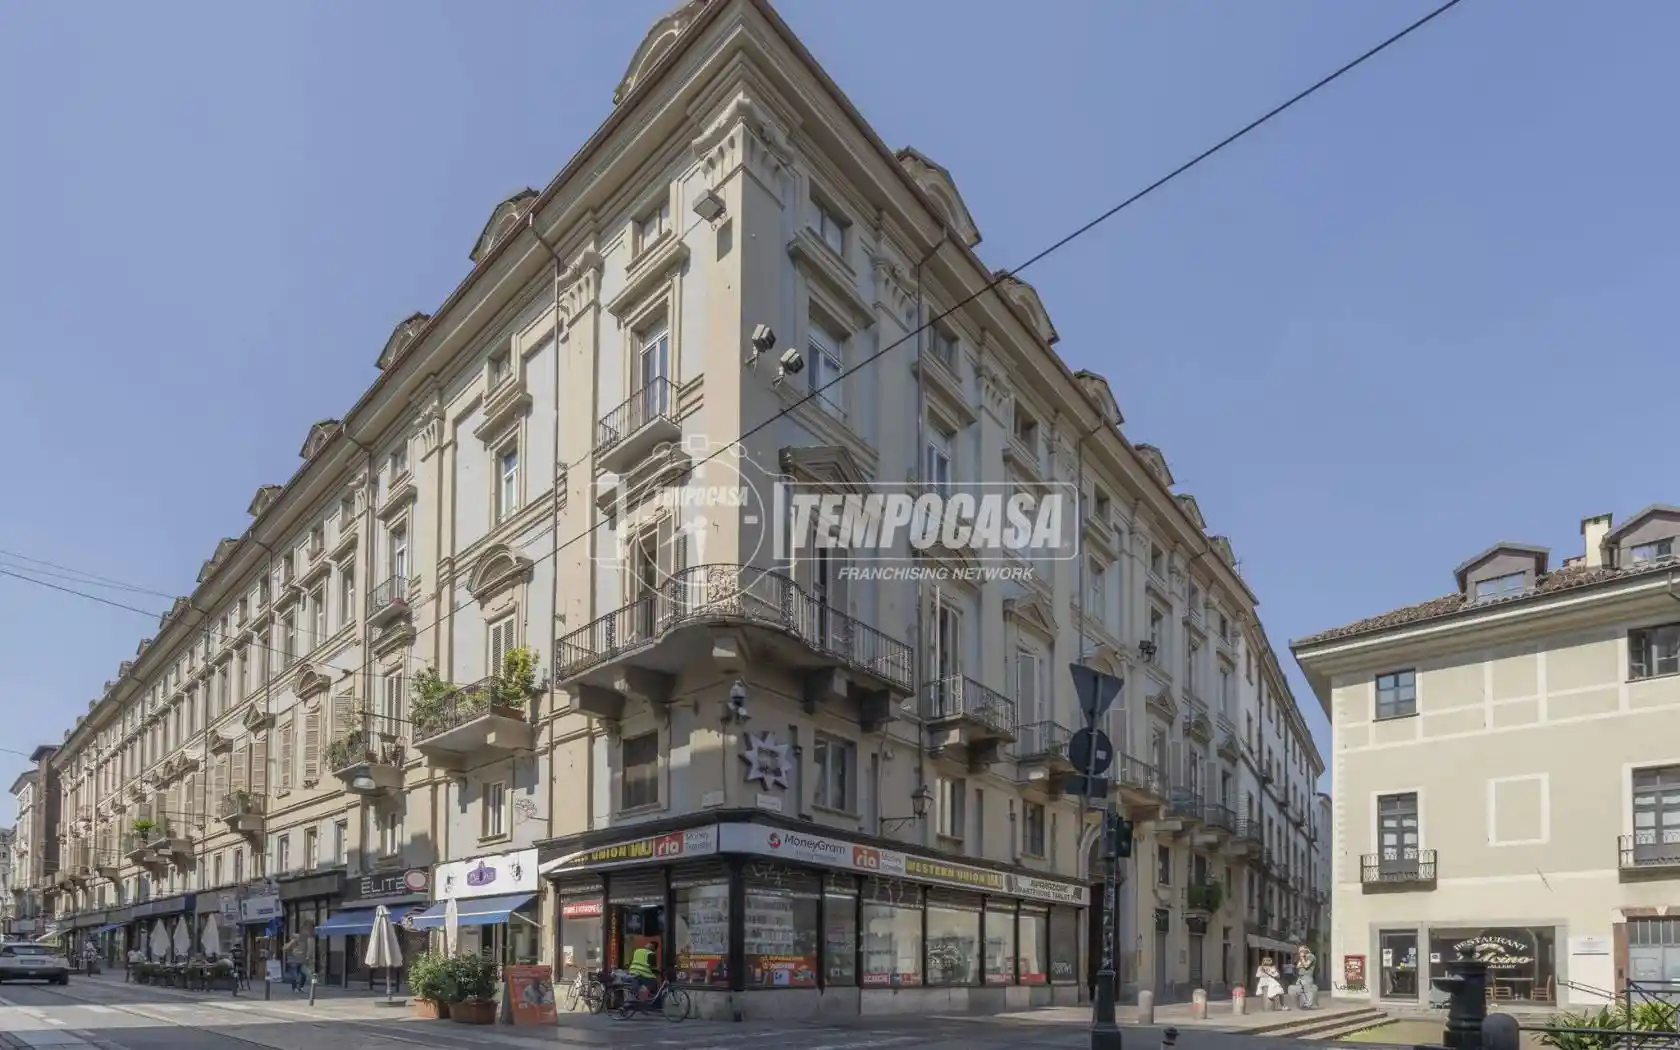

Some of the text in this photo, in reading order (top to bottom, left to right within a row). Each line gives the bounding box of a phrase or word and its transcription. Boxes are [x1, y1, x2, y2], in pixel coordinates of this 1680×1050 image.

[592, 845, 627, 861] UNION
[657, 837, 680, 856] ria
[784, 833, 846, 855] MoneyGram
[856, 849, 877, 867] ria
[906, 859, 955, 877] WESTERN
[956, 868, 986, 886] UNION
